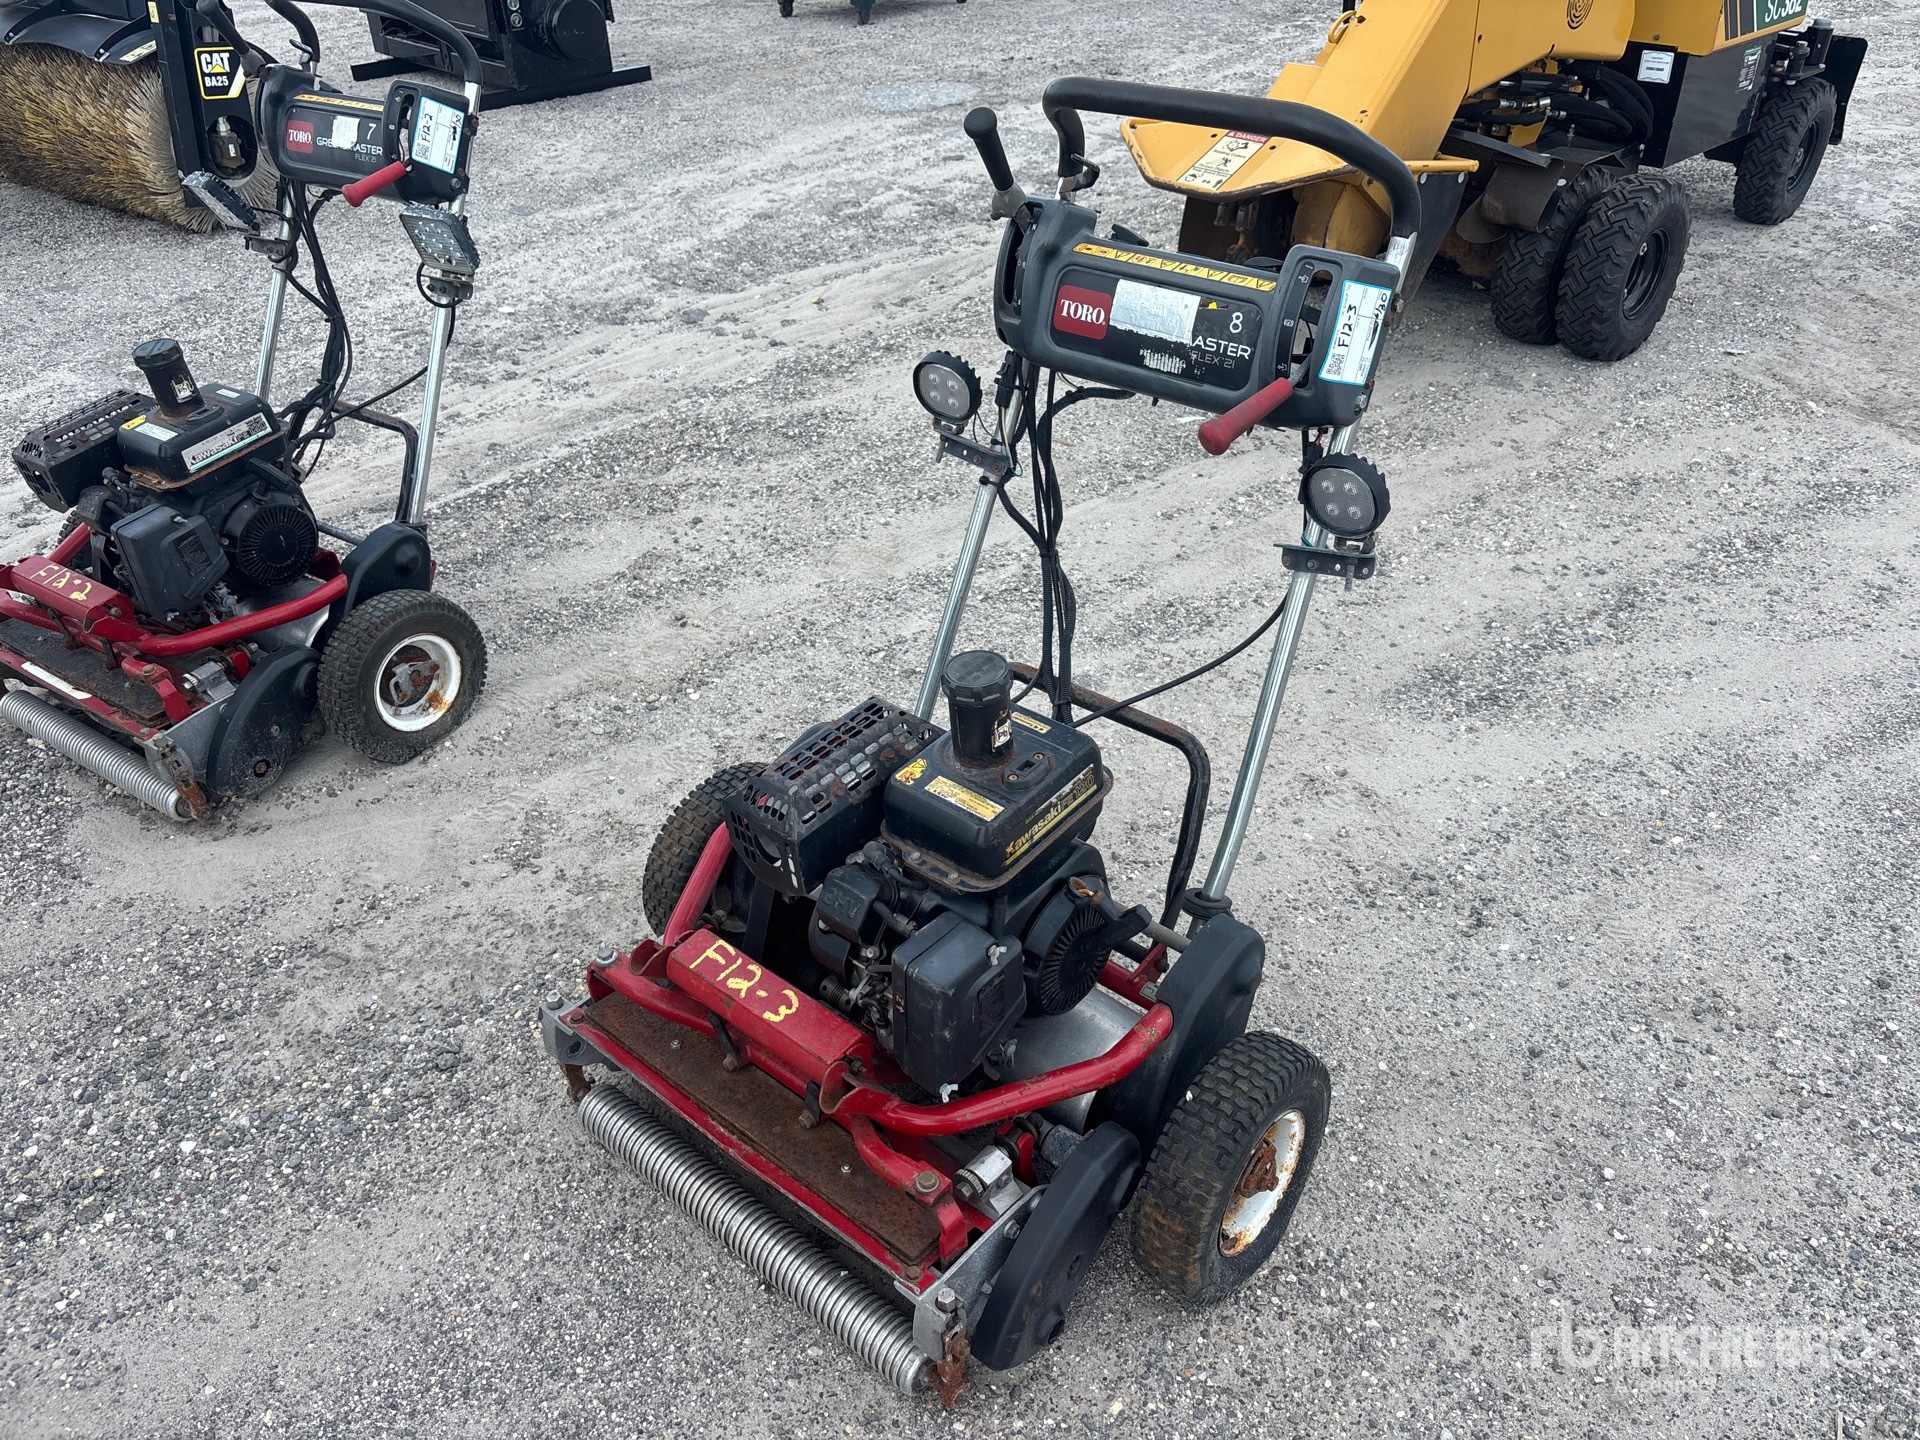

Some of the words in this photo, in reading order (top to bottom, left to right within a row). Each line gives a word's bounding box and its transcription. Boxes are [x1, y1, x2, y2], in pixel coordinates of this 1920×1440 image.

[200, 52, 230, 73] CAT
[204, 75, 229, 87] BA25
[288, 129, 312, 144] TORO
[366, 122, 377, 140] 7
[420, 113, 433, 143] F12-2
[1235, 131, 1268, 143] DANGER
[1059, 298, 1106, 326] TORO
[1229, 311, 1244, 334] 8
[1337, 303, 1357, 348] F12-3
[187, 436, 238, 465] Kawasaki
[1005, 802, 1062, 858] Kawasaki
[1074, 774, 1095, 799] 120
[689, 939, 799, 1022] F12-3
